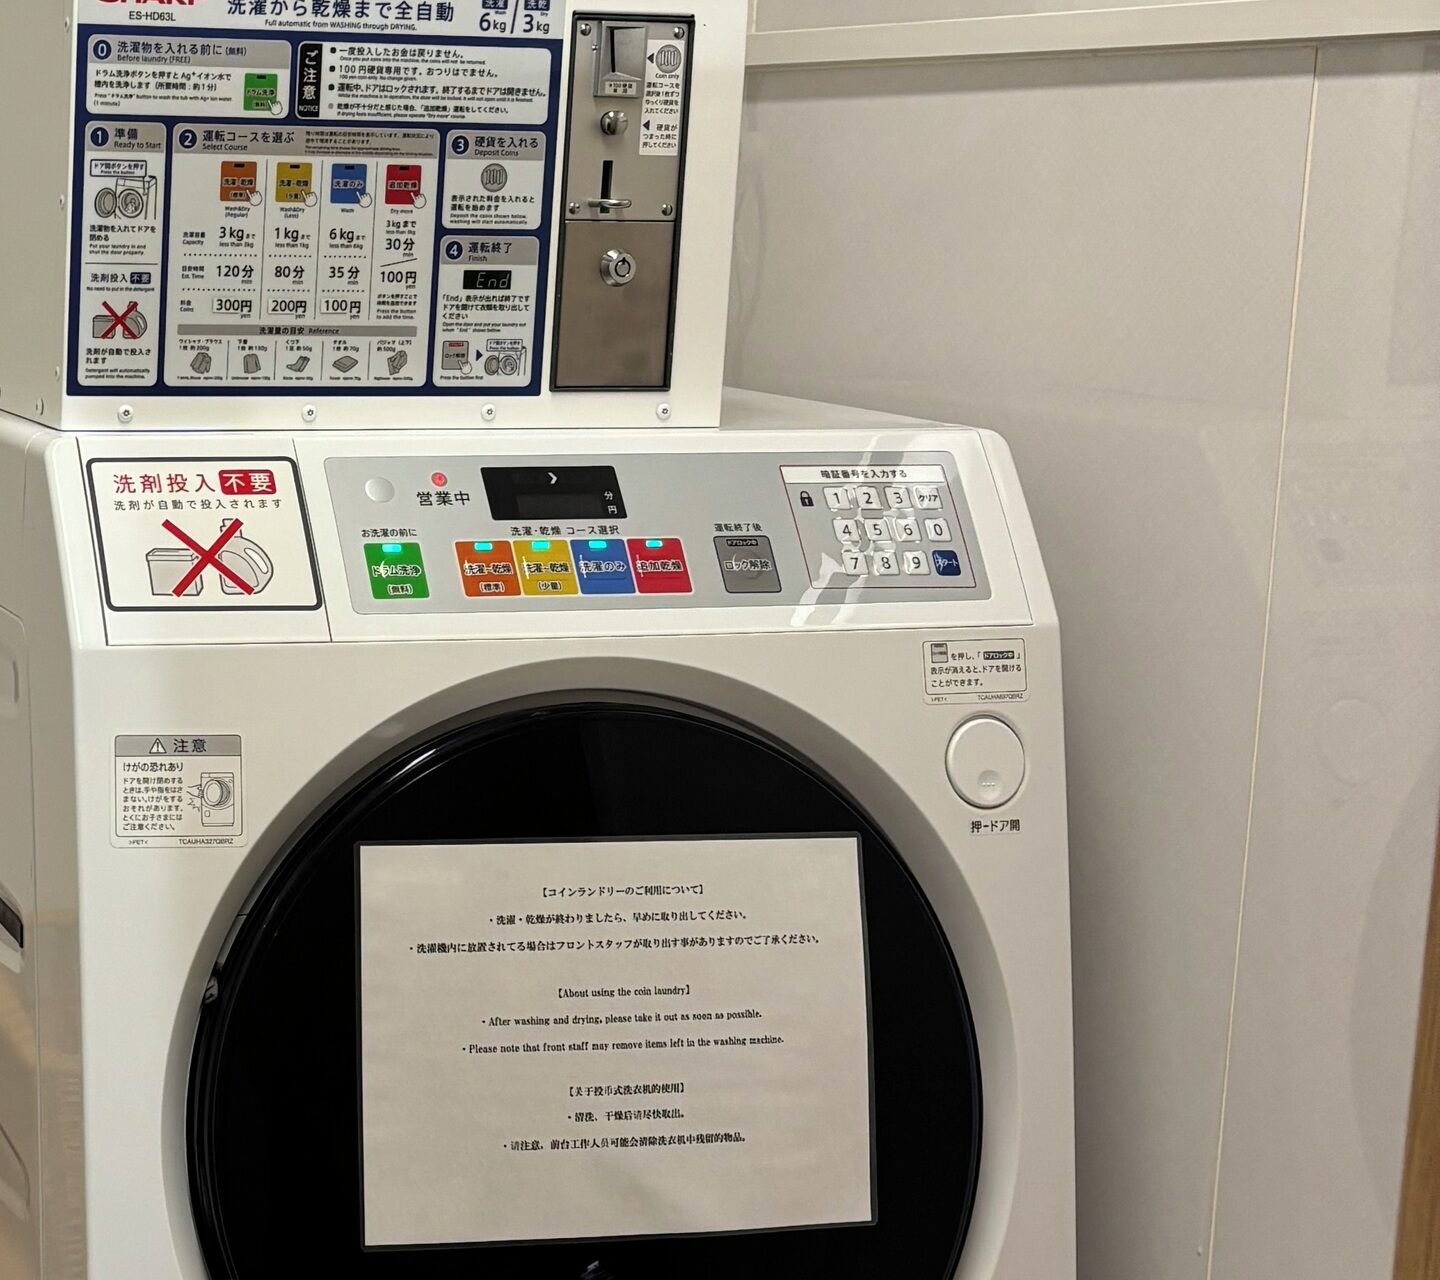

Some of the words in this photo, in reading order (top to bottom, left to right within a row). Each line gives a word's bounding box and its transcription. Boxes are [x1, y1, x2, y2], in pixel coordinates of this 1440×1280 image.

[128, 10, 176, 22] ES-HD63L
[278, 20, 311, 28] automatic
[312, 21, 329, 29] from
[329, 22, 361, 30] WASHING
[362, 23, 389, 31] through
[117, 41, 222, 56] 洗濯物を入れる前に
[339, 47, 464, 58] 一度投入したお金は戻りません。
[141, 55, 168, 64] laundry
[302, 49, 318, 100] ご注意
[298, 104, 319, 112] NOTICE
[114, 128, 138, 140] 準備
[202, 129, 295, 144] 運転コースを選ぶ
[113, 141, 135, 150] Ready
[145, 142, 161, 150] Start
[474, 136, 538, 148] 硬貨を入れる
[474, 149, 500, 157] Deposit
[500, 149, 519, 157] Coins
[468, 242, 513, 254] 運転終了
[90, 273, 128, 283] 洗剤投入
[131, 273, 150, 283] 不要
[476, 271, 510, 289] End
[216, 299, 252, 313] 300円
[271, 300, 307, 313] 200円
[325, 300, 361, 313] 100円
[112, 472, 216, 494] 洗剤投入
[223, 472, 274, 492] 不要
[113, 498, 282, 511] 洗剤が自動で投入されます
[416, 490, 471, 507] 営業中
[832, 492, 841, 504] 1
[864, 492, 873, 505] 2
[895, 492, 903, 504] 3
[361, 528, 418, 538] お洗濯の前に
[566, 525, 620, 535] コース選択
[842, 523, 852, 536] 4
[873, 523, 882, 536] 5
[904, 523, 913, 536] 6
[934, 523, 943, 536] 0
[850, 557, 859, 569] 7
[881, 556, 891, 569] 8
[912, 556, 921, 569] 9
[931, 679, 984, 688] ことができます。
[173, 738, 207, 753] 注意
[123, 762, 184, 772] けがの恐れあり
[542, 884, 704, 897] 【コインランドリーのご利用について】
[591, 988, 615, 998] using
[618, 987, 632, 996] the
[634, 986, 652, 995] coin
[488, 1016, 511, 1026] After
[514, 1016, 550, 1027] washing
[553, 1015, 570, 1025] and
[605, 1014, 632, 1024] please
[634, 1013, 653, 1022] take
[654, 1012, 662, 1022] it
[663, 1013, 678, 1021] out
[726, 1009, 762, 1020] possible.
[468, 1044, 498, 1054] Please
[500, 1044, 520, 1053] note
[522, 1043, 541, 1052] that
[543, 1042, 566, 1052] front
[568, 1041, 589, 1051] staff
[591, 1043, 610, 1052] may
[612, 1041, 643, 1050] remove
[645, 1039, 668, 1049] items
[669, 1038, 685, 1048] left
[686, 1038, 696, 1047] in
[697, 1037, 711, 1046] the
[713, 1036, 747, 1047] washing
[749, 1035, 784, 1045] machine.
